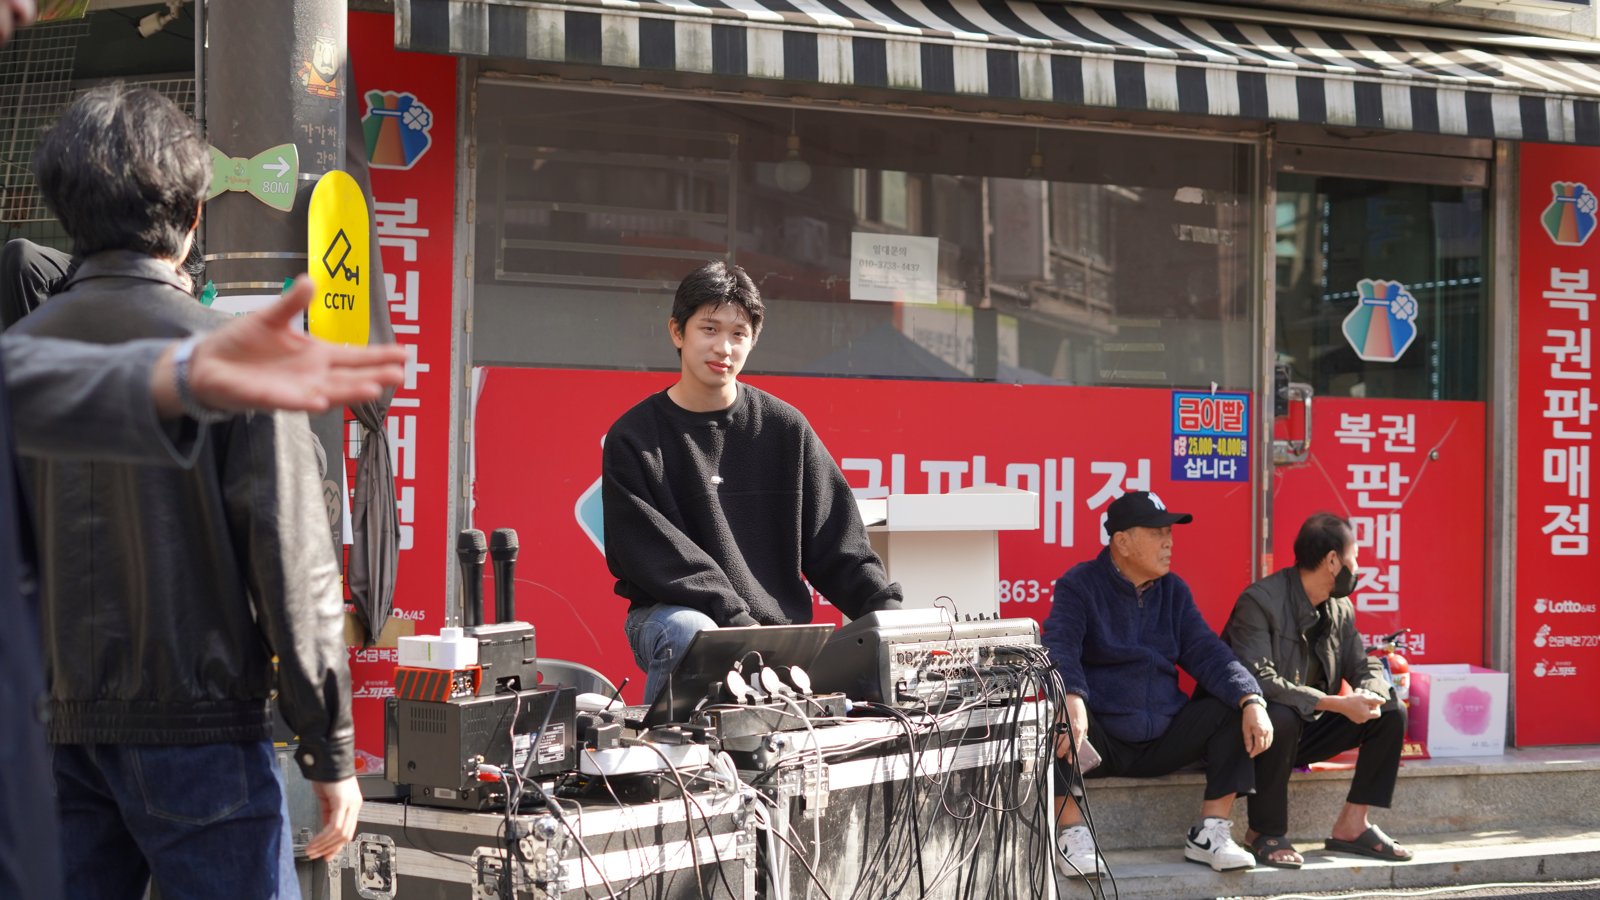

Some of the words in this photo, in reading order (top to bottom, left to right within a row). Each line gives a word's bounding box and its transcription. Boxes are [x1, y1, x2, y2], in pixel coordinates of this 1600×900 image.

[262, 181, 290, 194] 80M
[872, 244, 908, 257] 임대문의
[324, 292, 355, 311] CCTV
[1179, 397, 1245, 433] 금이빨
[1541, 266, 1599, 556] 복권판매점
[1334, 412, 1416, 453] 복권
[1183, 457, 1238, 480] 삽니다
[999, 579, 1055, 604] 863-
